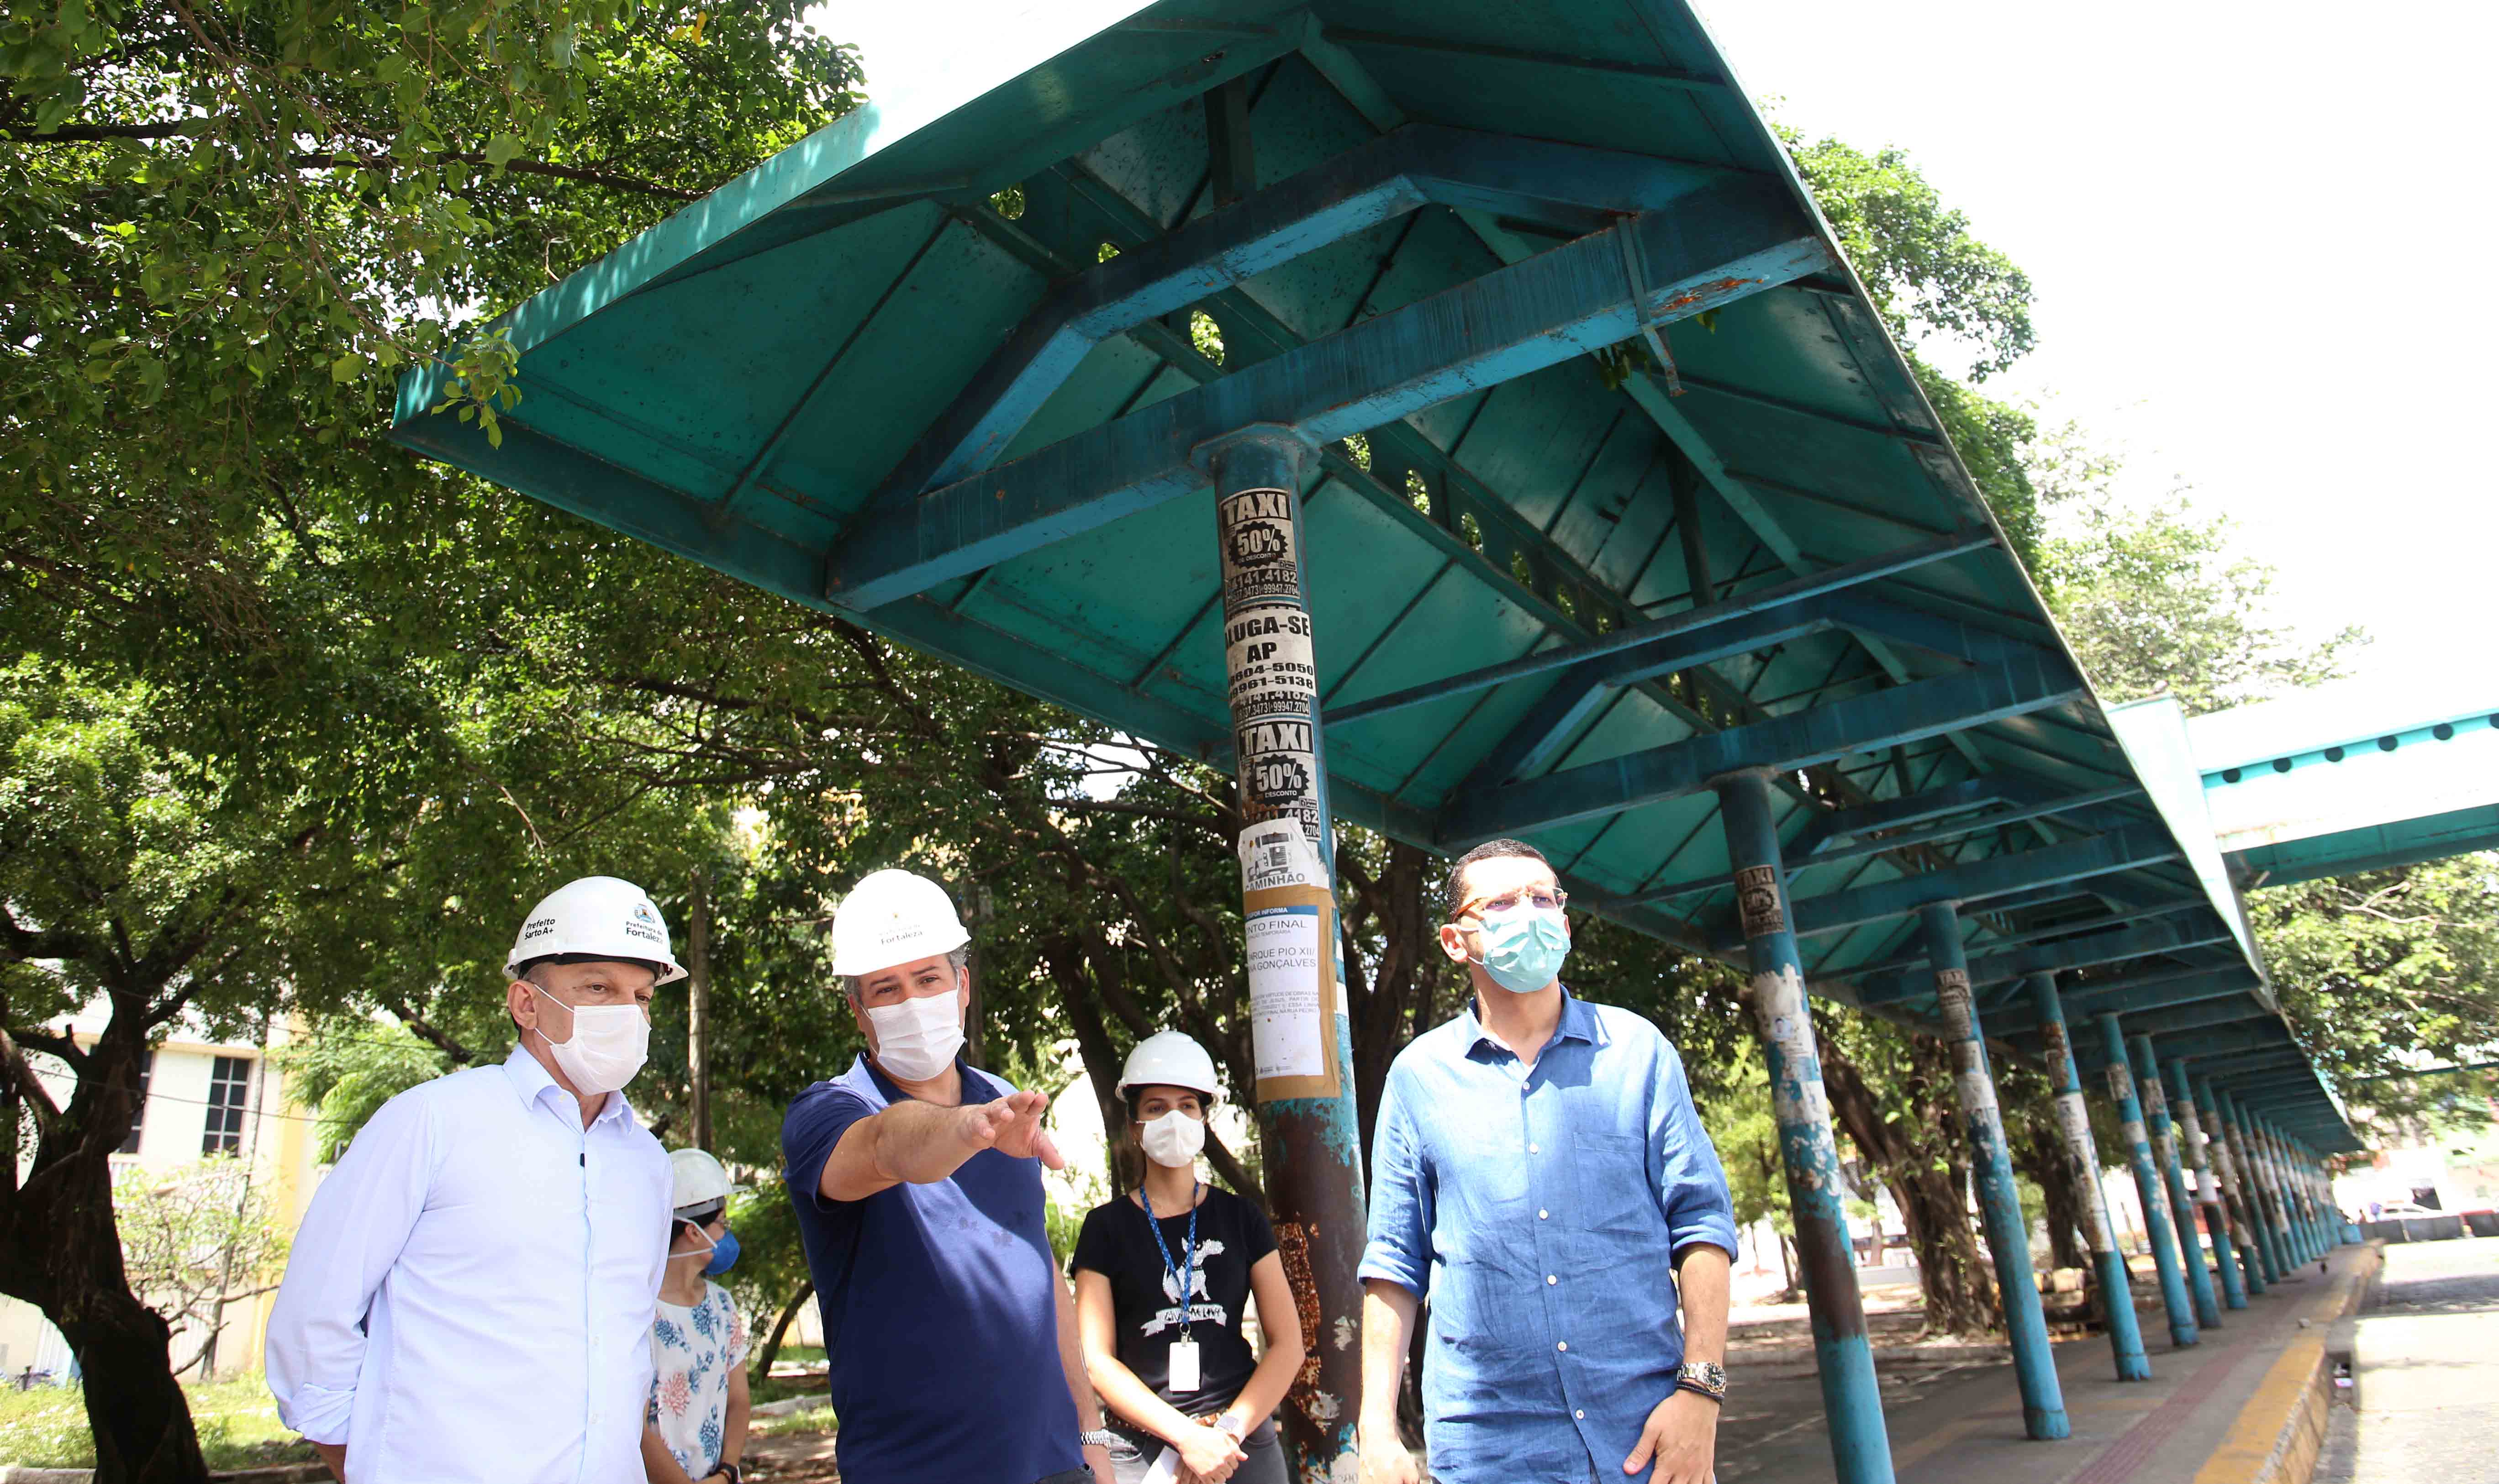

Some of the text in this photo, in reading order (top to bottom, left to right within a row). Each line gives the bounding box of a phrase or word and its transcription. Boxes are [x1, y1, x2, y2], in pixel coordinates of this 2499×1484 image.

[1223, 493, 1287, 526] TAXI
[1237, 529, 1280, 556] 50%
[1247, 642, 1277, 663] AP
[1241, 724, 1309, 755] TAXI
[1257, 763, 1302, 792] 50%
[1265, 790, 1297, 798] DESCONTO
[526, 919, 555, 931] Prefeito
[1269, 920, 1308, 929] FINAL
[524, 930, 542, 940] Sarto
[626, 927, 664, 945] Fortaleza
[1279, 947, 1296, 956] PIO
[1257, 959, 1316, 970] GONÇALVES
